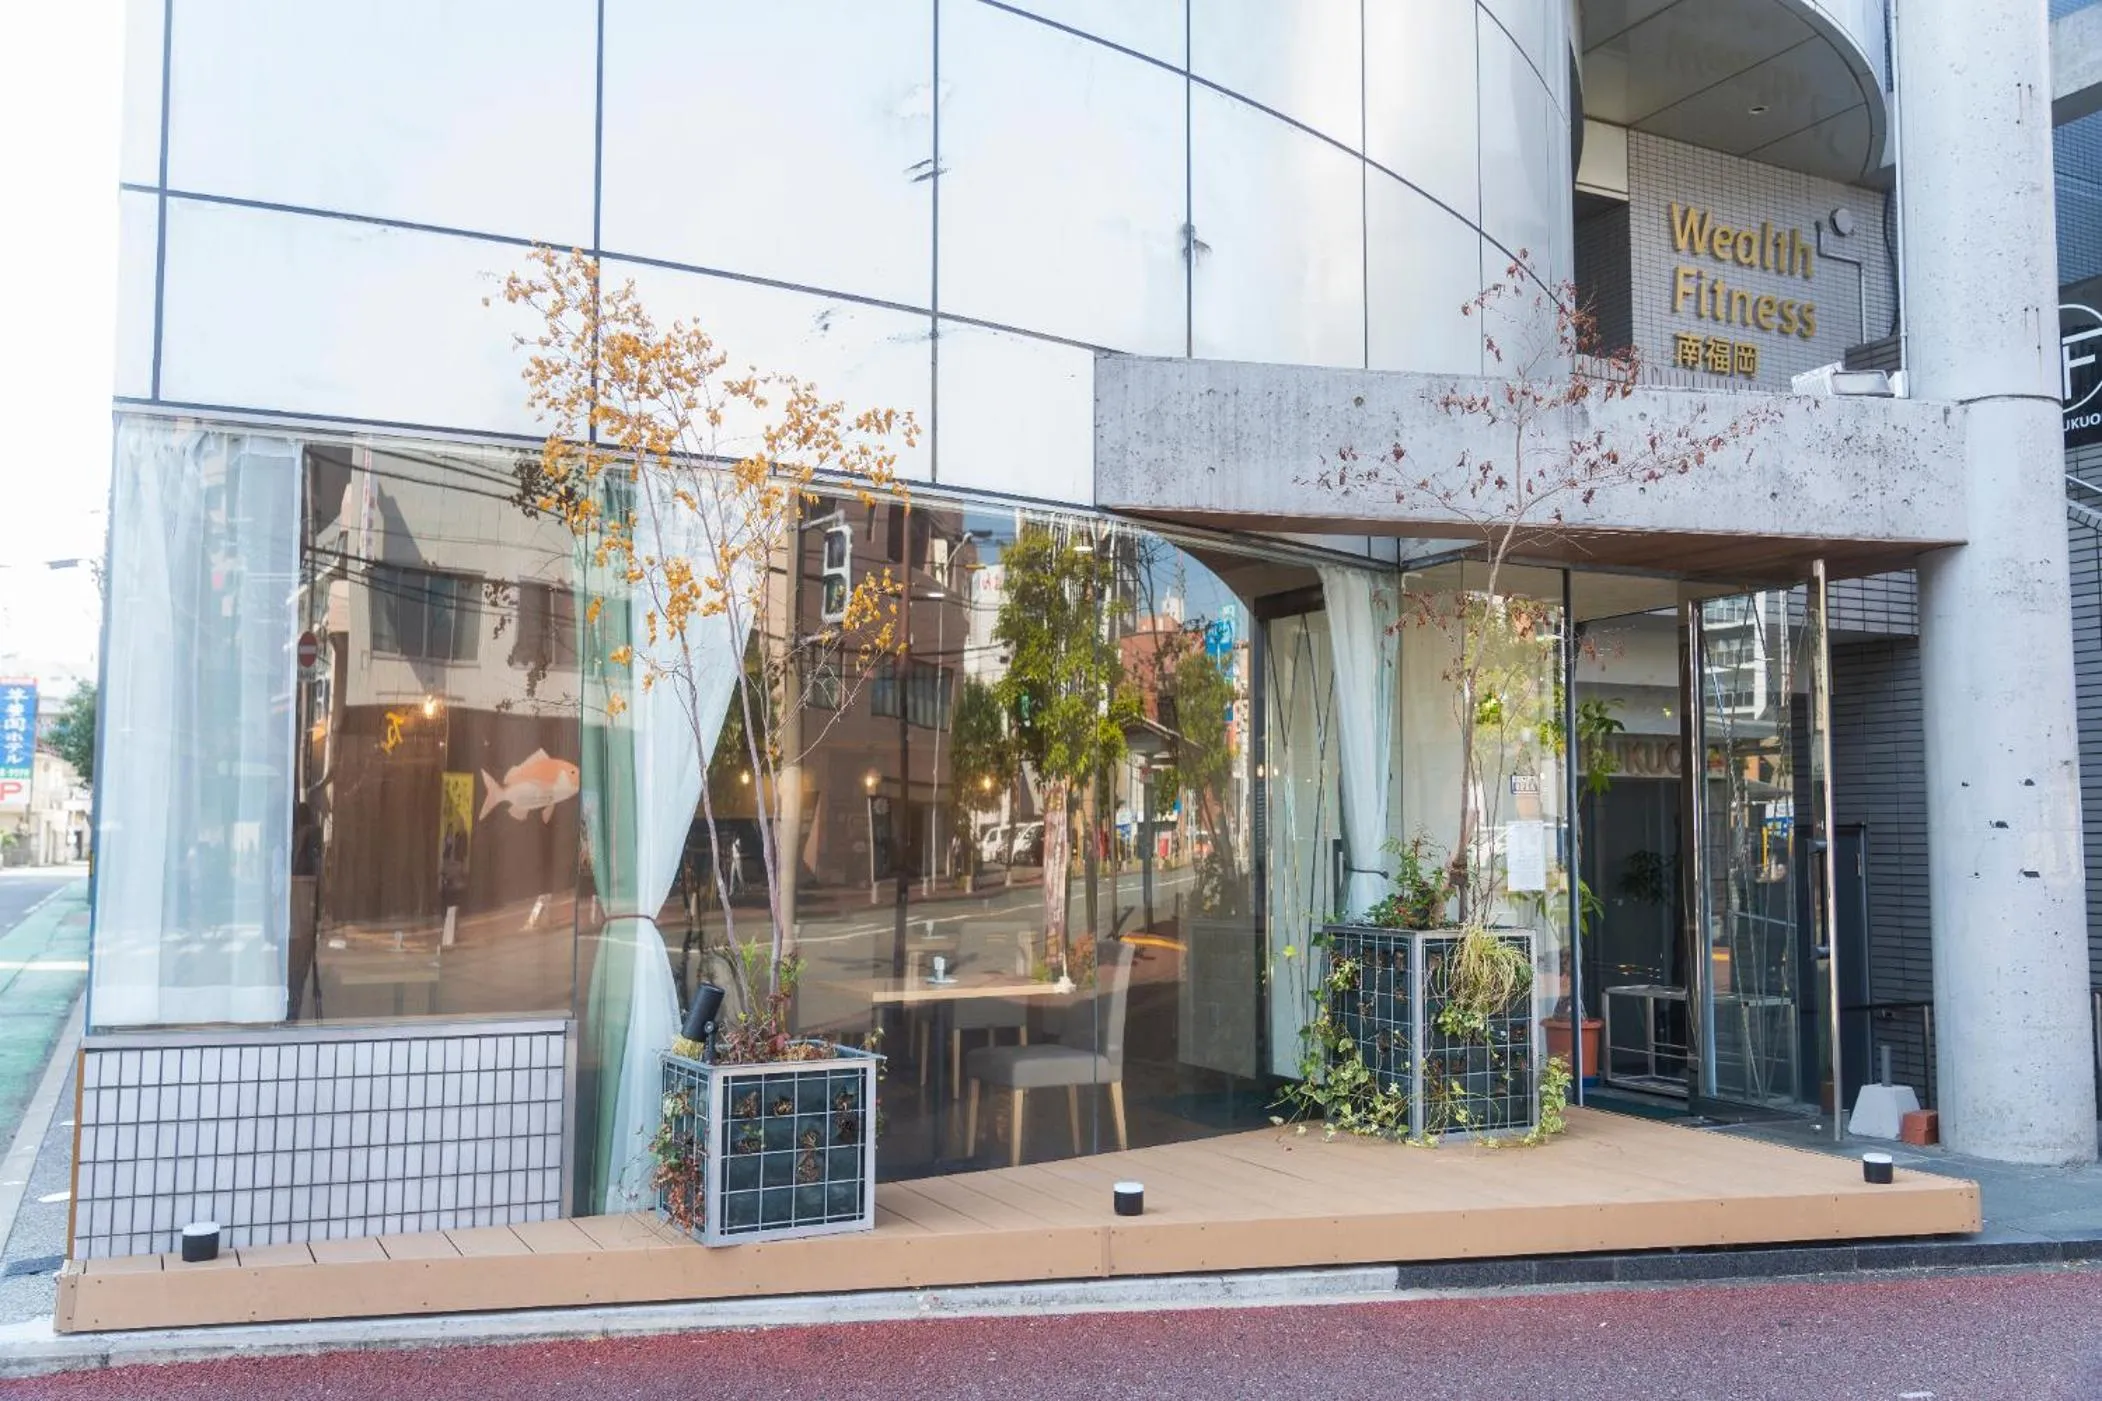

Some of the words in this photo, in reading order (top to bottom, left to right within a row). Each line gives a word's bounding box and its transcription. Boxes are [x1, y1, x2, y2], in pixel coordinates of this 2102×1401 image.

[1671, 201, 1815, 279] Wealth
[1672, 265, 1817, 338] Fitness
[1673, 331, 1758, 378] 南福岡
[2063, 412, 2102, 432] UKUO
